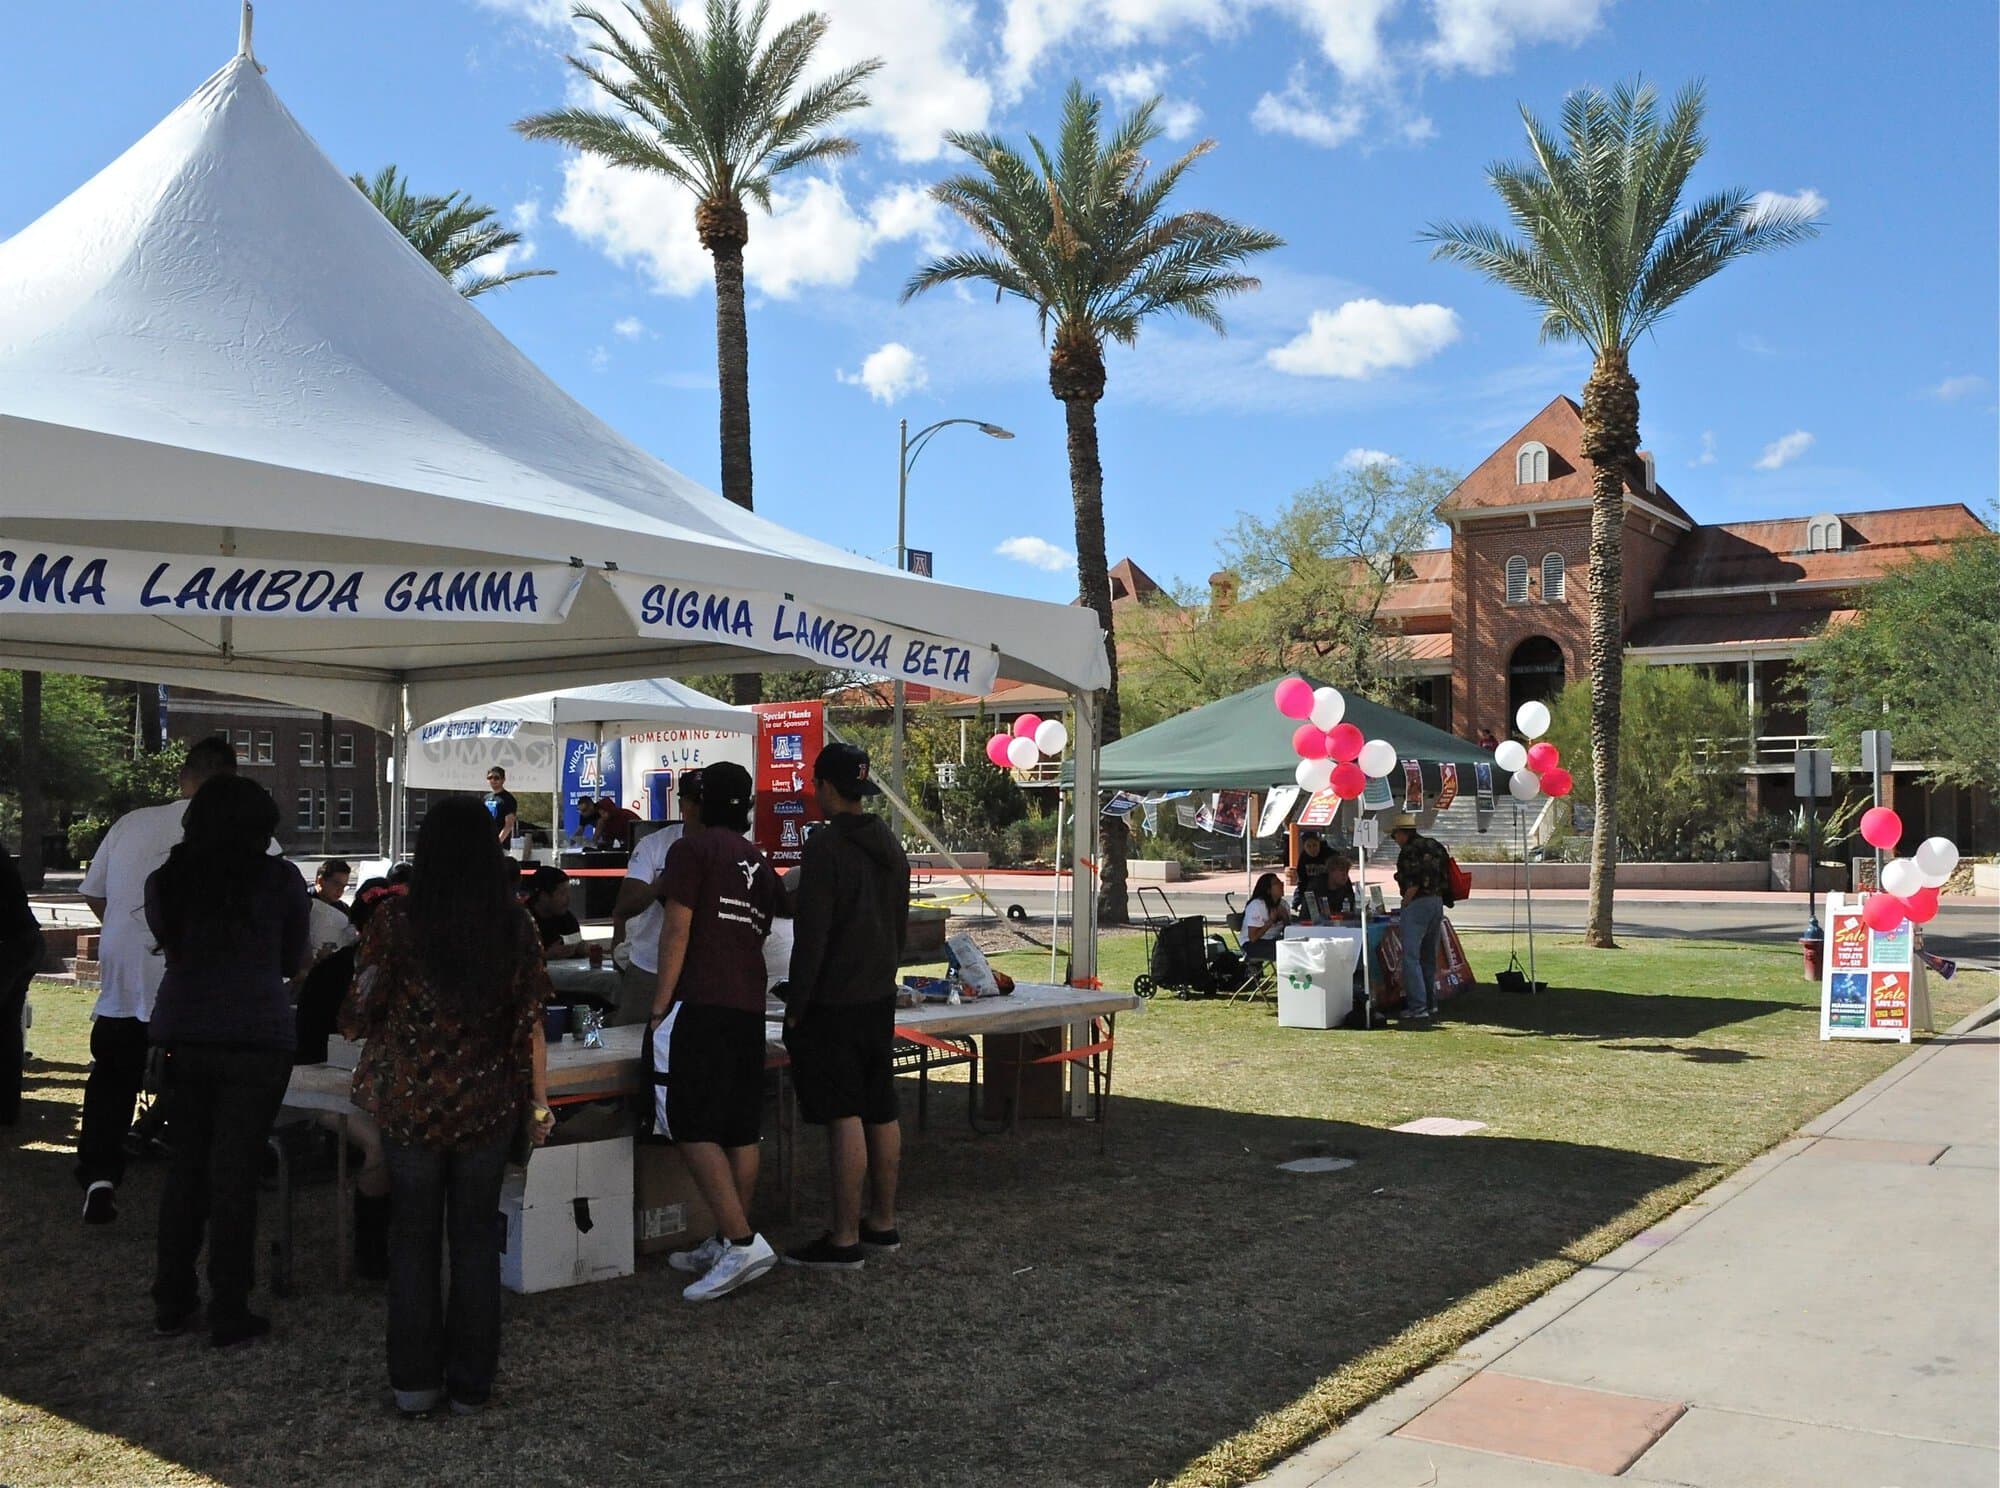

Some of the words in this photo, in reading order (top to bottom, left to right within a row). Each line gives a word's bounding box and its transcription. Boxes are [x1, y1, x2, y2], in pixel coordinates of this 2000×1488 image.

[140, 563, 364, 613] LAMBDA
[385, 571, 538, 613] GAMMA
[641, 584, 753, 637] SIGMA
[773, 605, 892, 669] LAMBDA
[903, 641, 971, 683] BETA
[763, 711, 786, 721] Special
[788, 709, 811, 719] Thanks
[422, 722, 445, 740] KAMP
[447, 720, 486, 737] STUDENT
[783, 720, 809, 729] Sponsors
[629, 729, 710, 744] HOMECOMING
[772, 780, 790, 789] Liberty
[1835, 928, 1866, 942] Sale
[1873, 985, 1906, 1001] Sale
